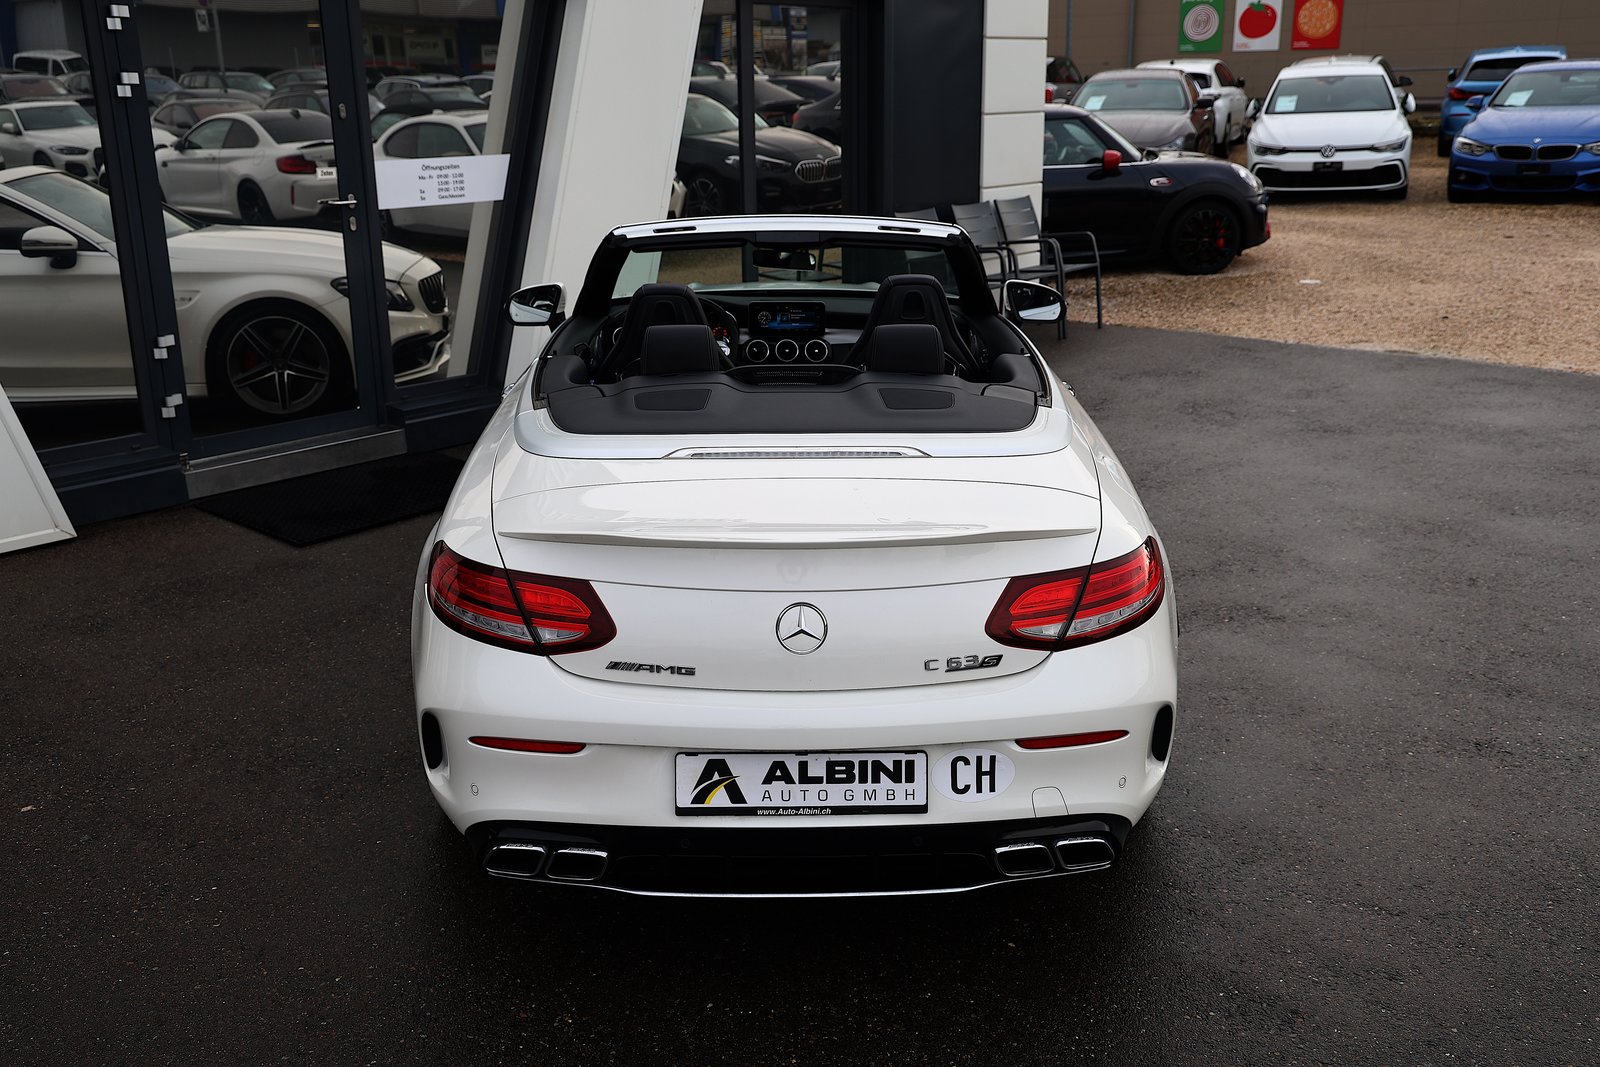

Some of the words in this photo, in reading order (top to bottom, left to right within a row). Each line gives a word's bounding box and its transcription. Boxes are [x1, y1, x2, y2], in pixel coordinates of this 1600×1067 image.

[924, 658, 940, 672] C
[761, 759, 916, 785] ALBINI
[950, 755, 997, 796] CH
[761, 789, 830, 802] AUTO
[843, 789, 916, 802] GMBH
[757, 807, 832, 816] www.Auto-Albini.ch
